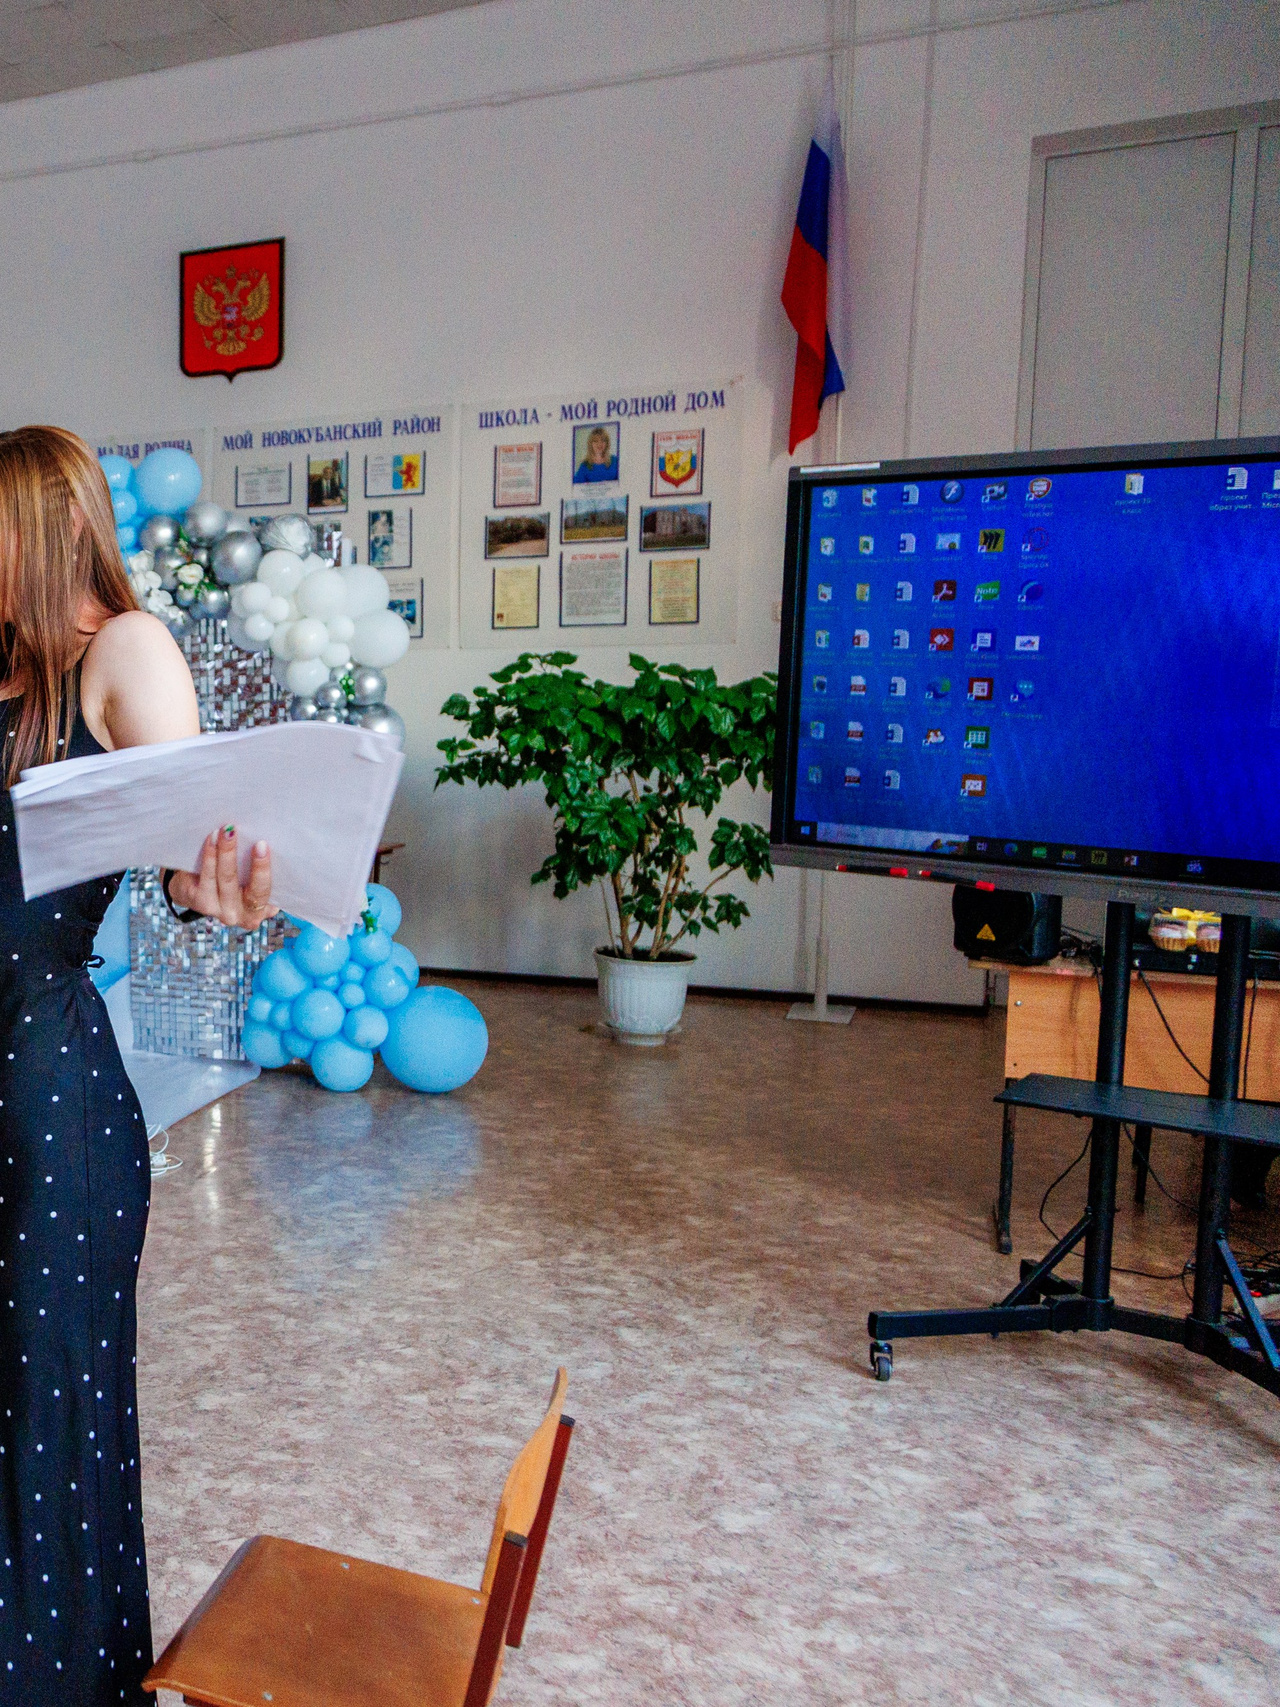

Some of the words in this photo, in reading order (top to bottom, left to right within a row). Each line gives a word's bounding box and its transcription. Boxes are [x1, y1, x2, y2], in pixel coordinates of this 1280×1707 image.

[479, 408, 540, 429] ШКОЛА
[559, 399, 598, 422] МОЙ
[606, 390, 676, 418] РОДНОЙ
[684, 389, 726, 412] ДОМ
[222, 430, 253, 451] МОЙ
[262, 418, 382, 447] НОВОКУБАНСКИЙ
[392, 414, 441, 436] РАЙОН
